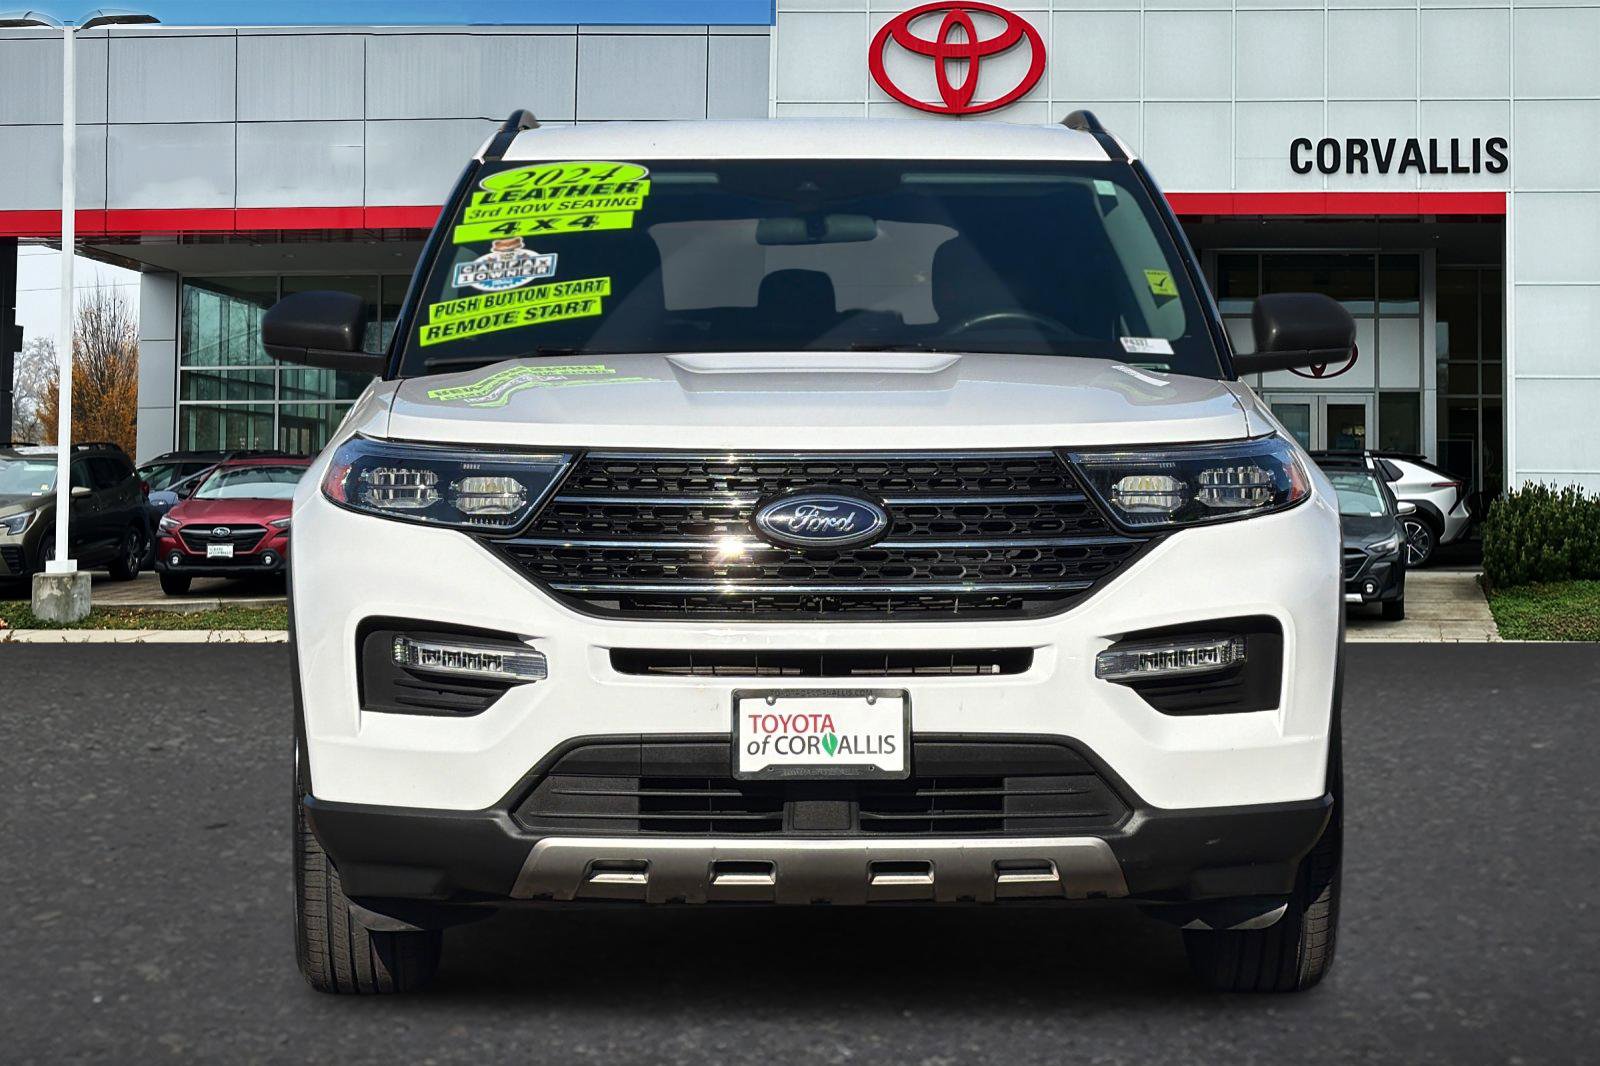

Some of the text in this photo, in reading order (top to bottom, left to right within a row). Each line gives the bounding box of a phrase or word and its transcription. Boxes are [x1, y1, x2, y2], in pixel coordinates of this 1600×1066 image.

[1290, 138, 1508, 174] CORVALLIS
[507, 165, 624, 188] 2024
[479, 181, 643, 205] LEATHER
[468, 197, 639, 219] 3rd ROW SEATING
[434, 279, 608, 318] PUSH BUTTON START
[426, 299, 596, 341] REMOTE START
[788, 504, 855, 532] Ford
[748, 714, 835, 733] TOYOTA
[747, 733, 896, 757] of CORVALLIS
